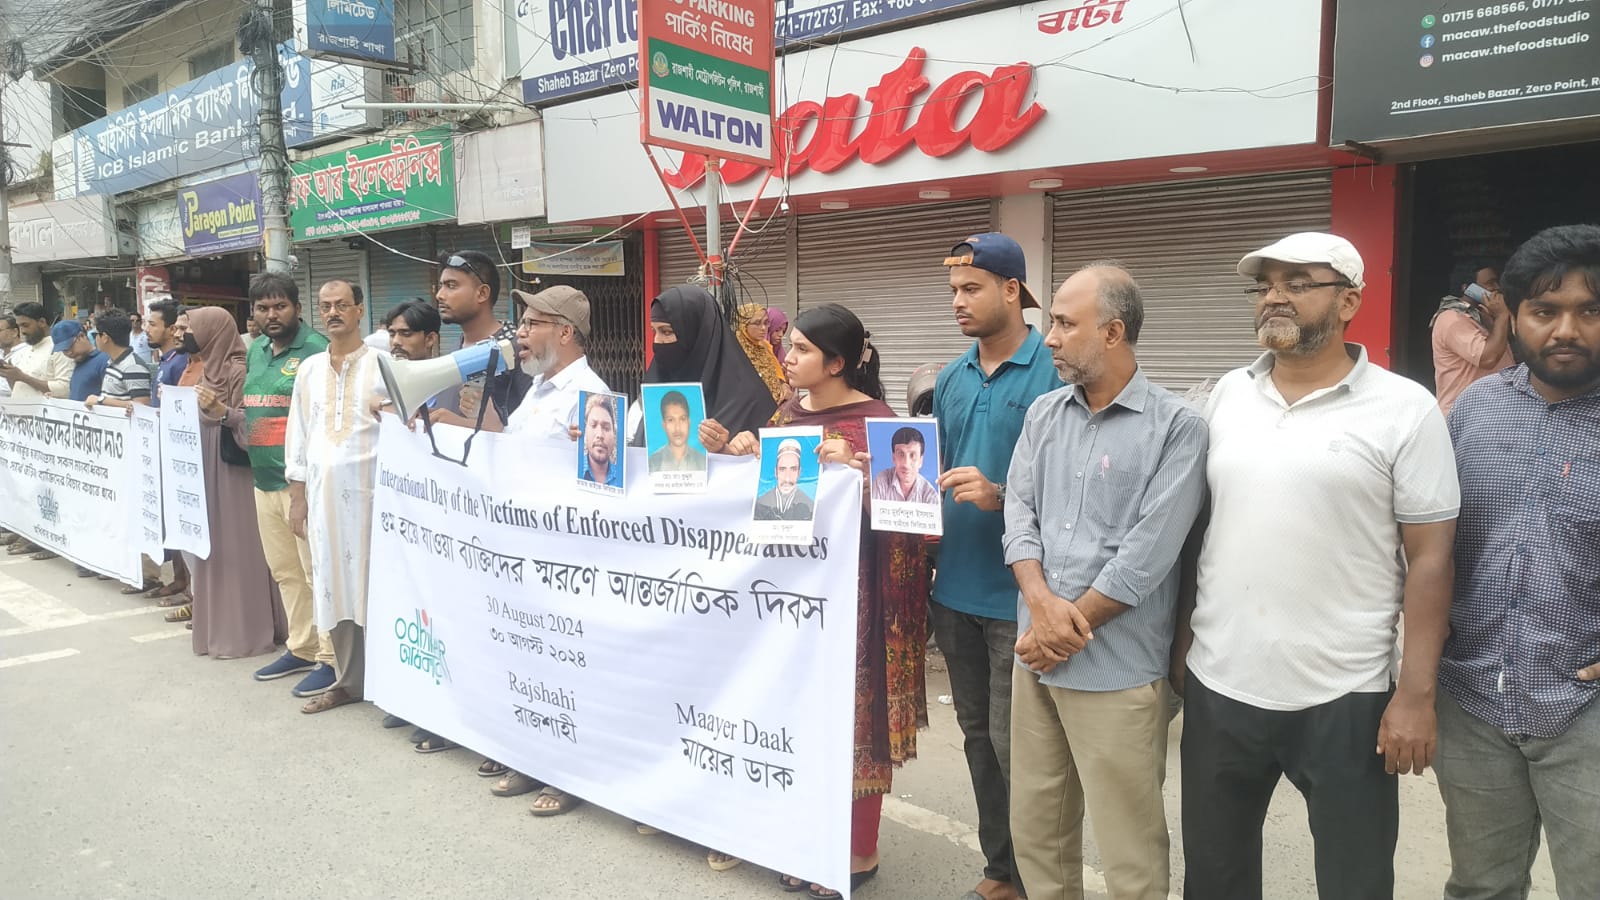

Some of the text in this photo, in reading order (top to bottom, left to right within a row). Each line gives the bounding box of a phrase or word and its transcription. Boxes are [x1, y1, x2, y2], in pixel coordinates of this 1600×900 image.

[549, 0, 638, 61] Charte
[775, 5, 849, 37] 721-772737,
[853, 0, 882, 19] Fax:
[1038, 0, 1130, 34] বাটা
[1442, 10, 1474, 23] 01715
[1477, 1, 1529, 19] 668566,
[1442, 11, 1590, 42] macaw.thefoodstudio
[317, 33, 386, 55] রাজশাহী শাখা
[665, 11, 753, 56] পার্কিং নিষেধ
[1442, 32, 1590, 63] macaw.thefoodstudio
[331, 75, 346, 92] Ria
[538, 57, 640, 94] Shaheb Bazar (Zero Po
[671, 62, 694, 80] রাজশাহী
[1391, 100, 1411, 110] 2nd
[1412, 97, 1441, 108] Floor,
[1443, 90, 1486, 104] Shaheb
[1487, 87, 1523, 99] Bazar,
[1525, 83, 1552, 95] Zero
[1554, 78, 1588, 91] Point,
[97, 111, 137, 157] আইসিবি
[138, 94, 192, 145] ইসলামিক
[656, 99, 763, 148] WALTON
[663, 46, 1048, 190] ata
[98, 159, 124, 180] ICB
[128, 139, 189, 170] Islamic
[195, 118, 251, 150] Bank
[314, 163, 344, 204] আর
[182, 191, 228, 238] Paragon
[228, 198, 256, 225] Point
[243, 394, 292, 408] ANGLADES
[104, 429, 123, 460] দাও
[379, 462, 829, 562] International Day of the Victims of Enforced Disappearances
[381, 511, 828, 631] গুম হয়ে যাওয়া ব্যক্তিদের স্মরণে আন্তর্জাতিক দিবস
[486, 594, 584, 639] 30 August 2024
[490, 627, 587, 668] ৩০ আগস্ট ২০২৪
[508, 670, 576, 712] Rajshahi
[512, 703, 578, 744] রাজশাহী
[674, 702, 794, 754] Maayer Daak
[680, 737, 795, 792] মায়ের ডাক
